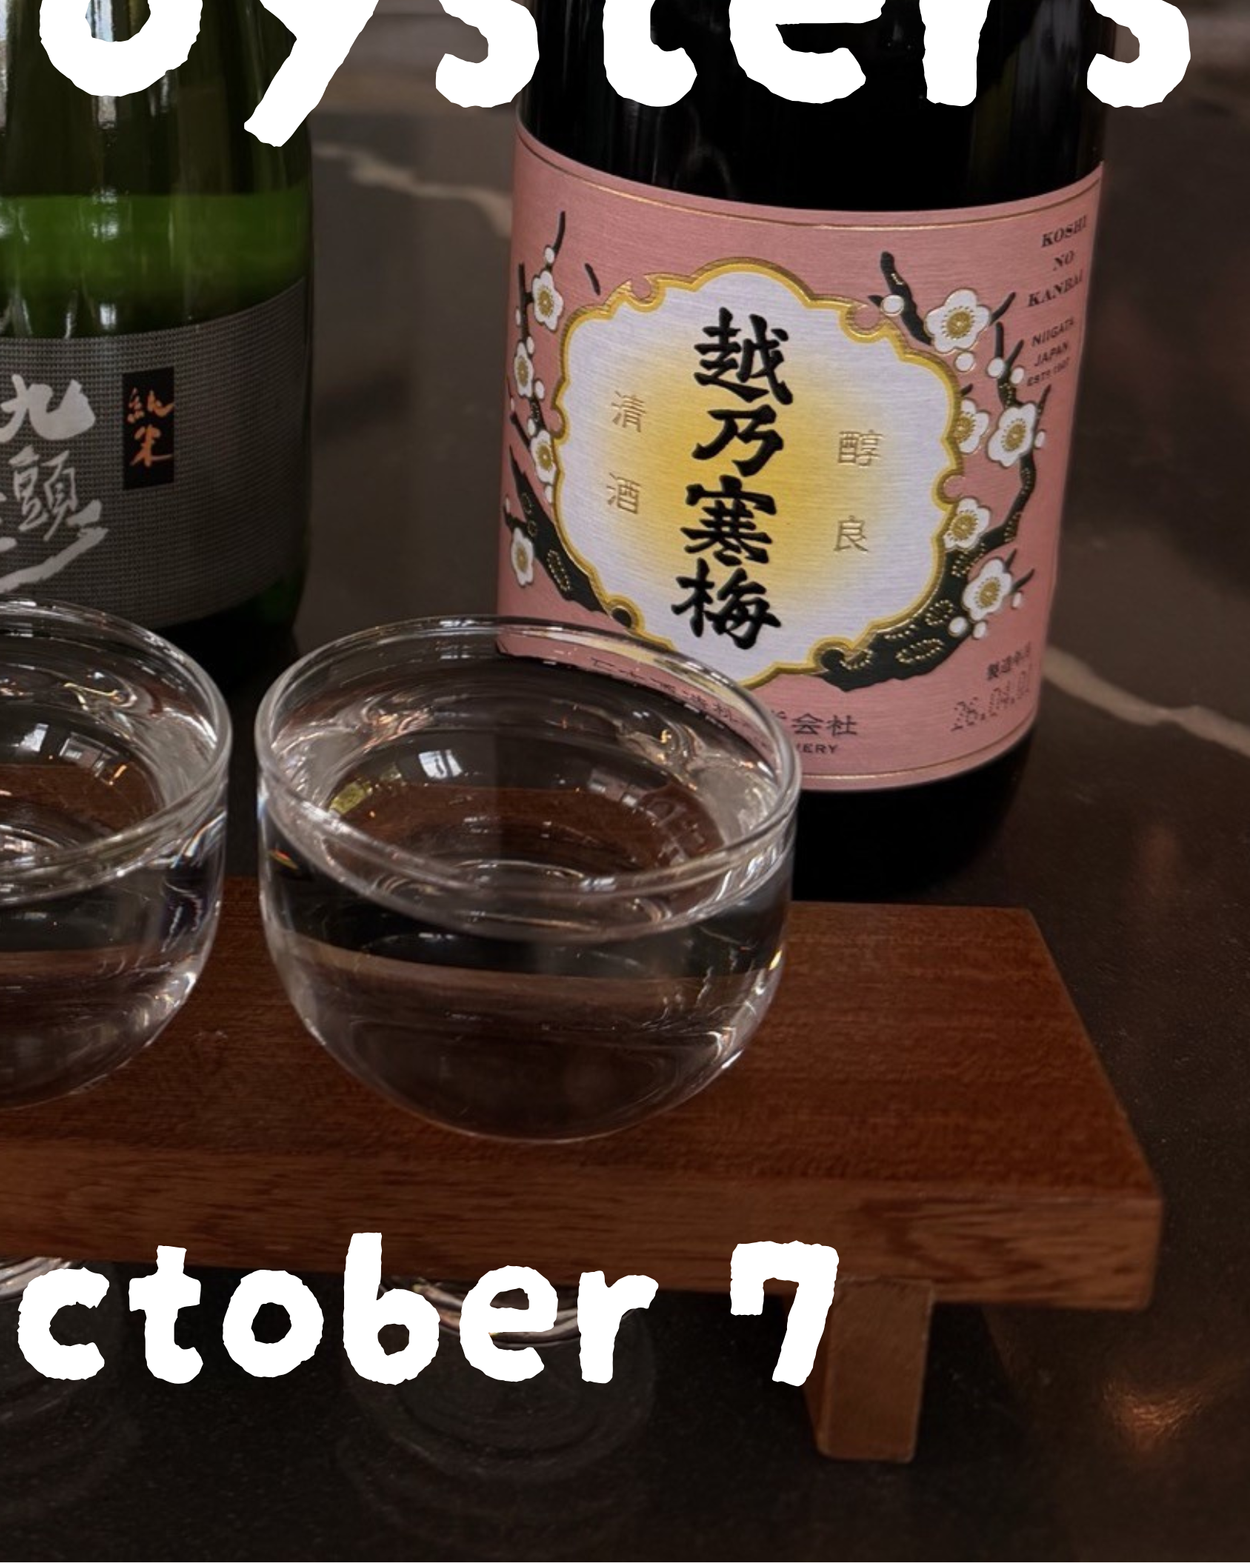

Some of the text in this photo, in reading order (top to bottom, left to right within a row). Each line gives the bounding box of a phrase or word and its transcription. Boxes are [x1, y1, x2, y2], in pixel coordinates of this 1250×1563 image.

[1041, 214, 1087, 248] KOSHI
[1053, 250, 1075, 271] NO
[1027, 269, 1084, 307] KANBAI
[1031, 317, 1075, 347] NIIGATA
[1034, 341, 1069, 367] JAPAN
[605, 390, 647, 516] 清酒
[671, 308, 793, 649] 越乃寒梅
[833, 429, 883, 555] 醇良
